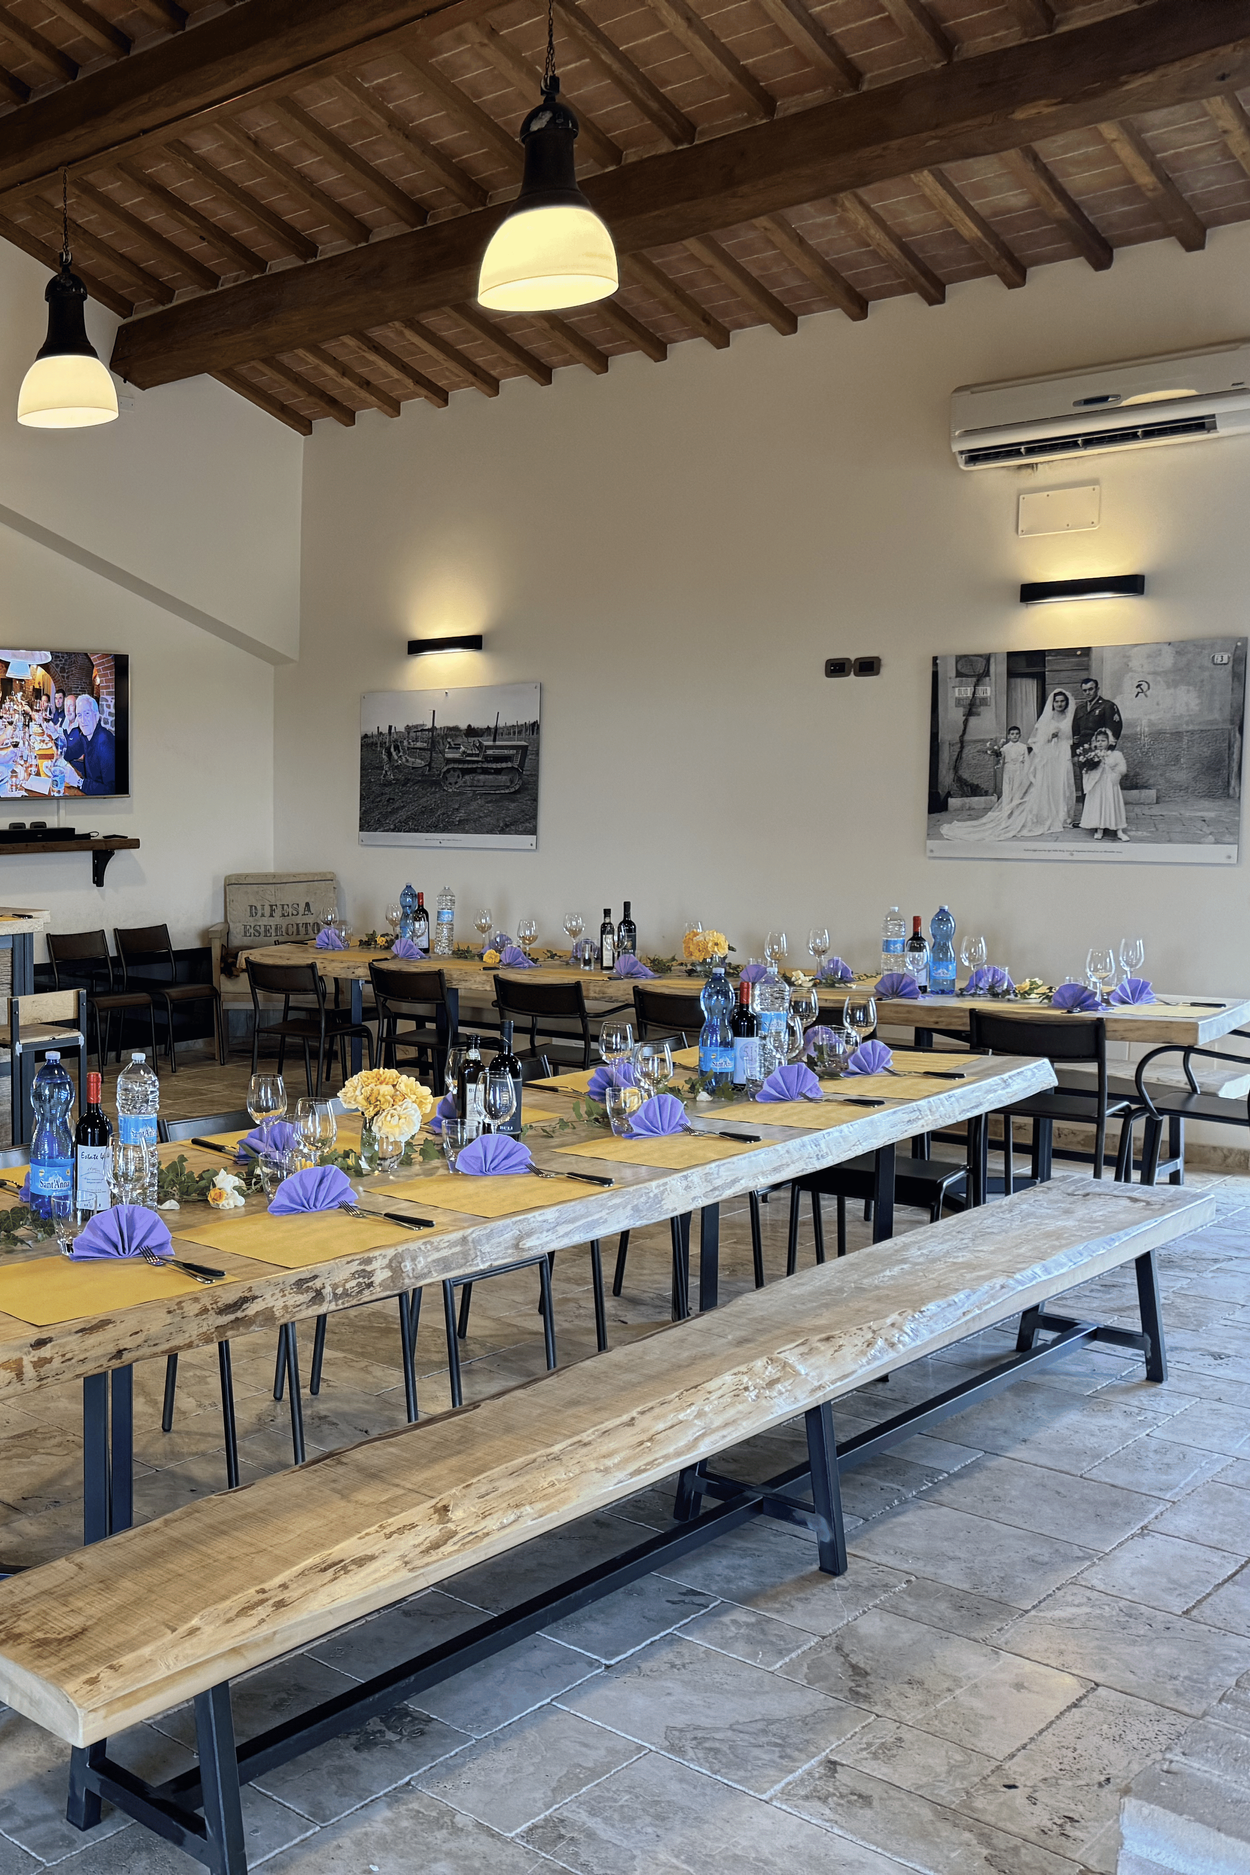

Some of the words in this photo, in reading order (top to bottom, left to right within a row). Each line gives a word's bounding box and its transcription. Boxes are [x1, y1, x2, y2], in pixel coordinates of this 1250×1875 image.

[248, 902, 314, 918] DIFESA
[242, 922, 321, 938] ESERCITO
[81, 1152, 98, 1160] Estate
[40, 1178, 70, 1189] Sant'Anna
